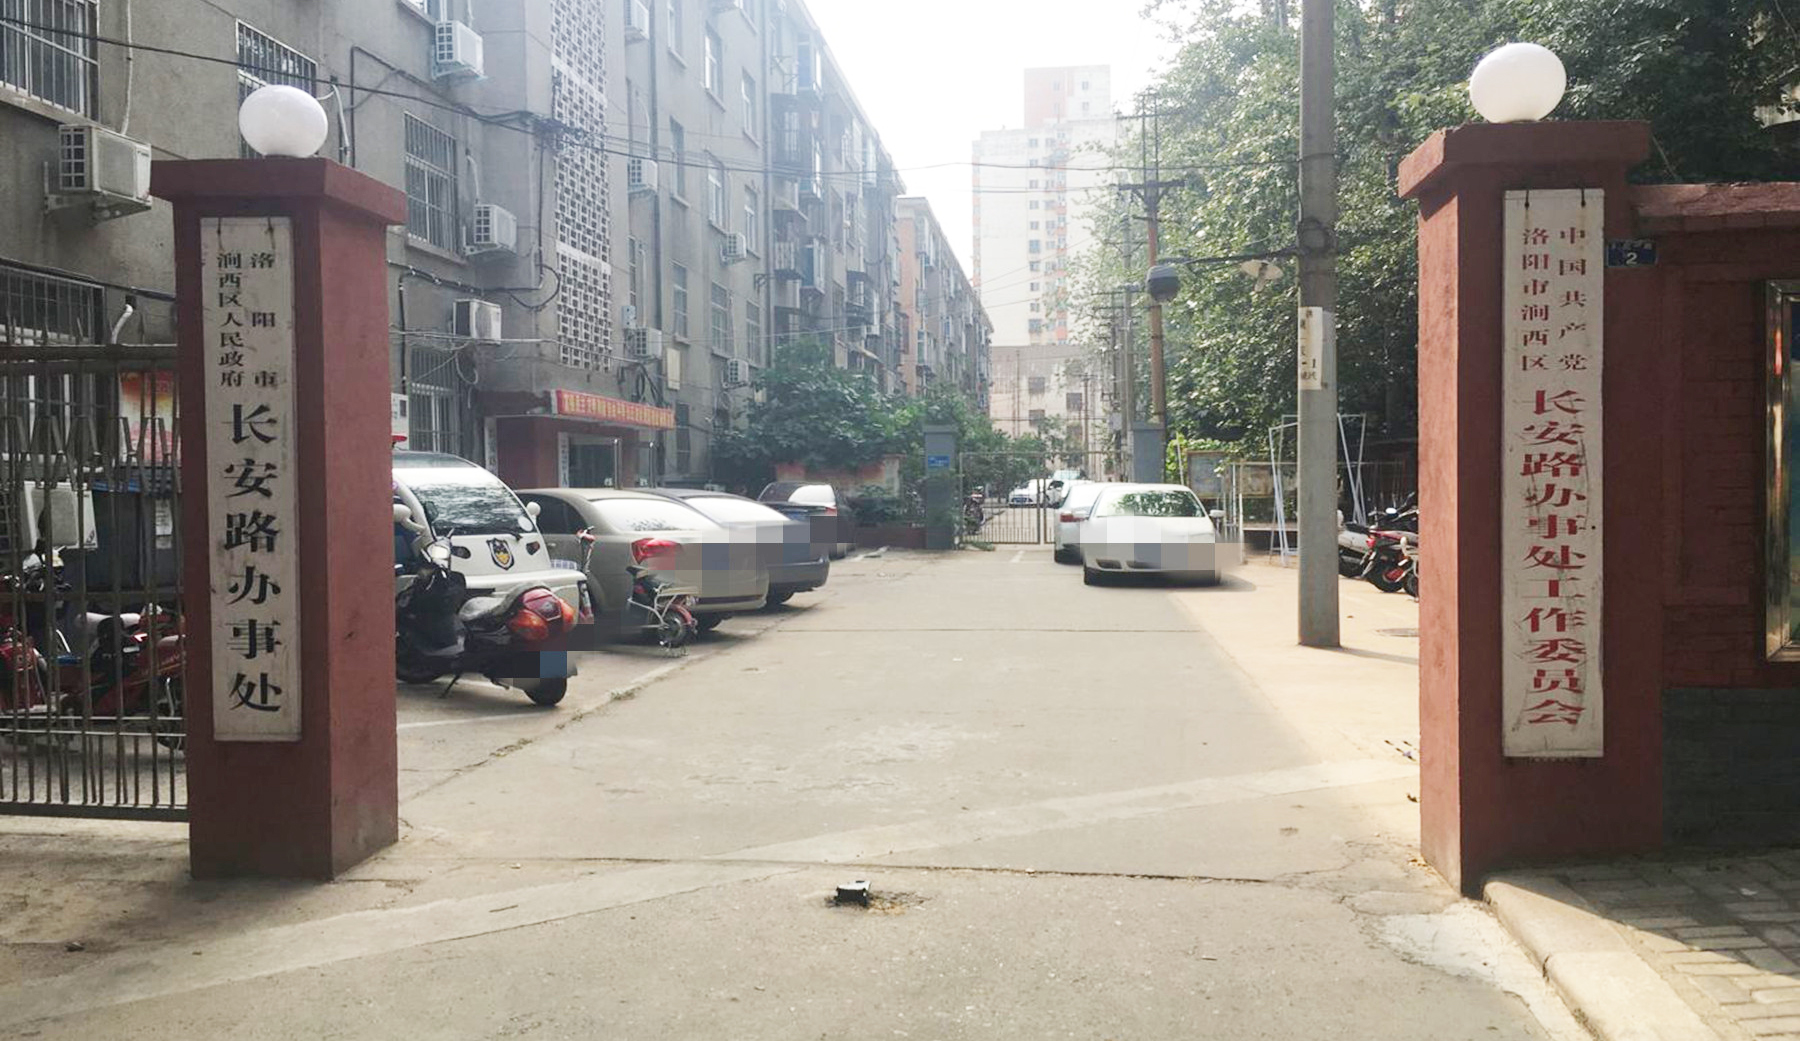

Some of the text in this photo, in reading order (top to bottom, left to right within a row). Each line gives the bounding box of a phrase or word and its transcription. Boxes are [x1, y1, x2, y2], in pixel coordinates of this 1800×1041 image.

[217, 252, 244, 388] 涧西区人民政府
[251, 252, 278, 389] 洛阳市
[1521, 229, 1549, 371] 洛阳市涧西区
[1558, 227, 1587, 371] 中国共产党
[1626, 252, 1638, 265] 2
[223, 404, 282, 712] 长安路办事处
[1520, 390, 1587, 725] 长安路办事处工作委员会
